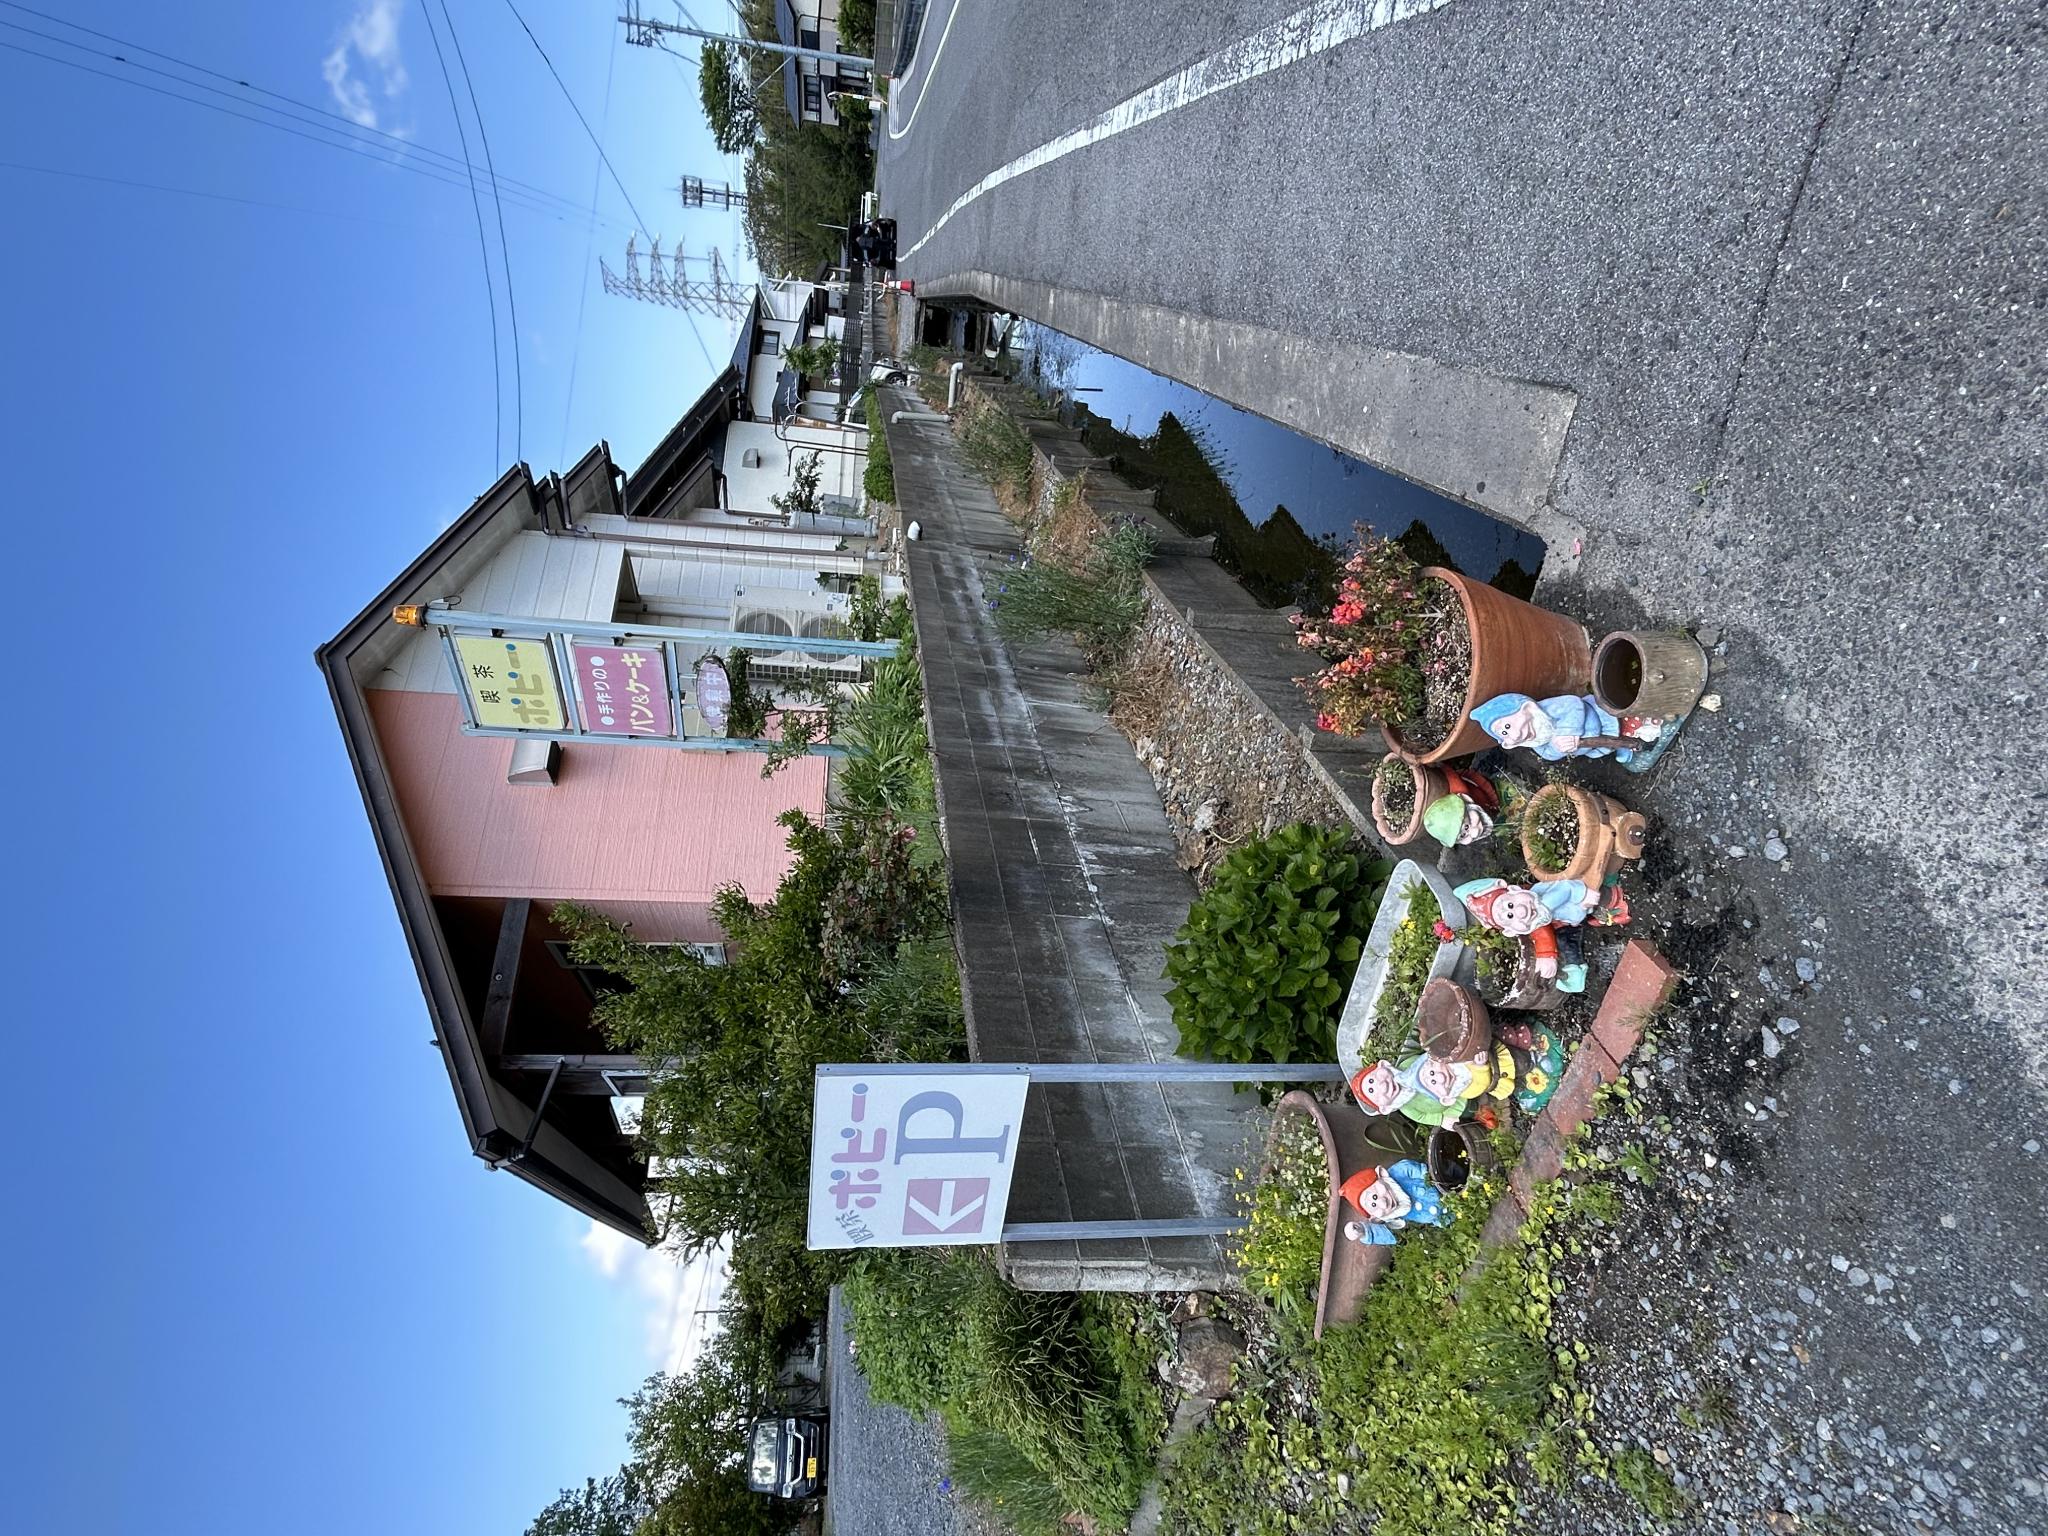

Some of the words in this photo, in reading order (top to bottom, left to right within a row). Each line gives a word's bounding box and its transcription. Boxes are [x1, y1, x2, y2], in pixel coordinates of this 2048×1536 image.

[472, 664, 500, 704] 喫茶
[590, 668, 614, 715] 手作りの
[620, 652, 656, 733] パン&ケーキ
[894, 1090, 1010, 1165] P
[835, 1209, 874, 1244] 喫茶
